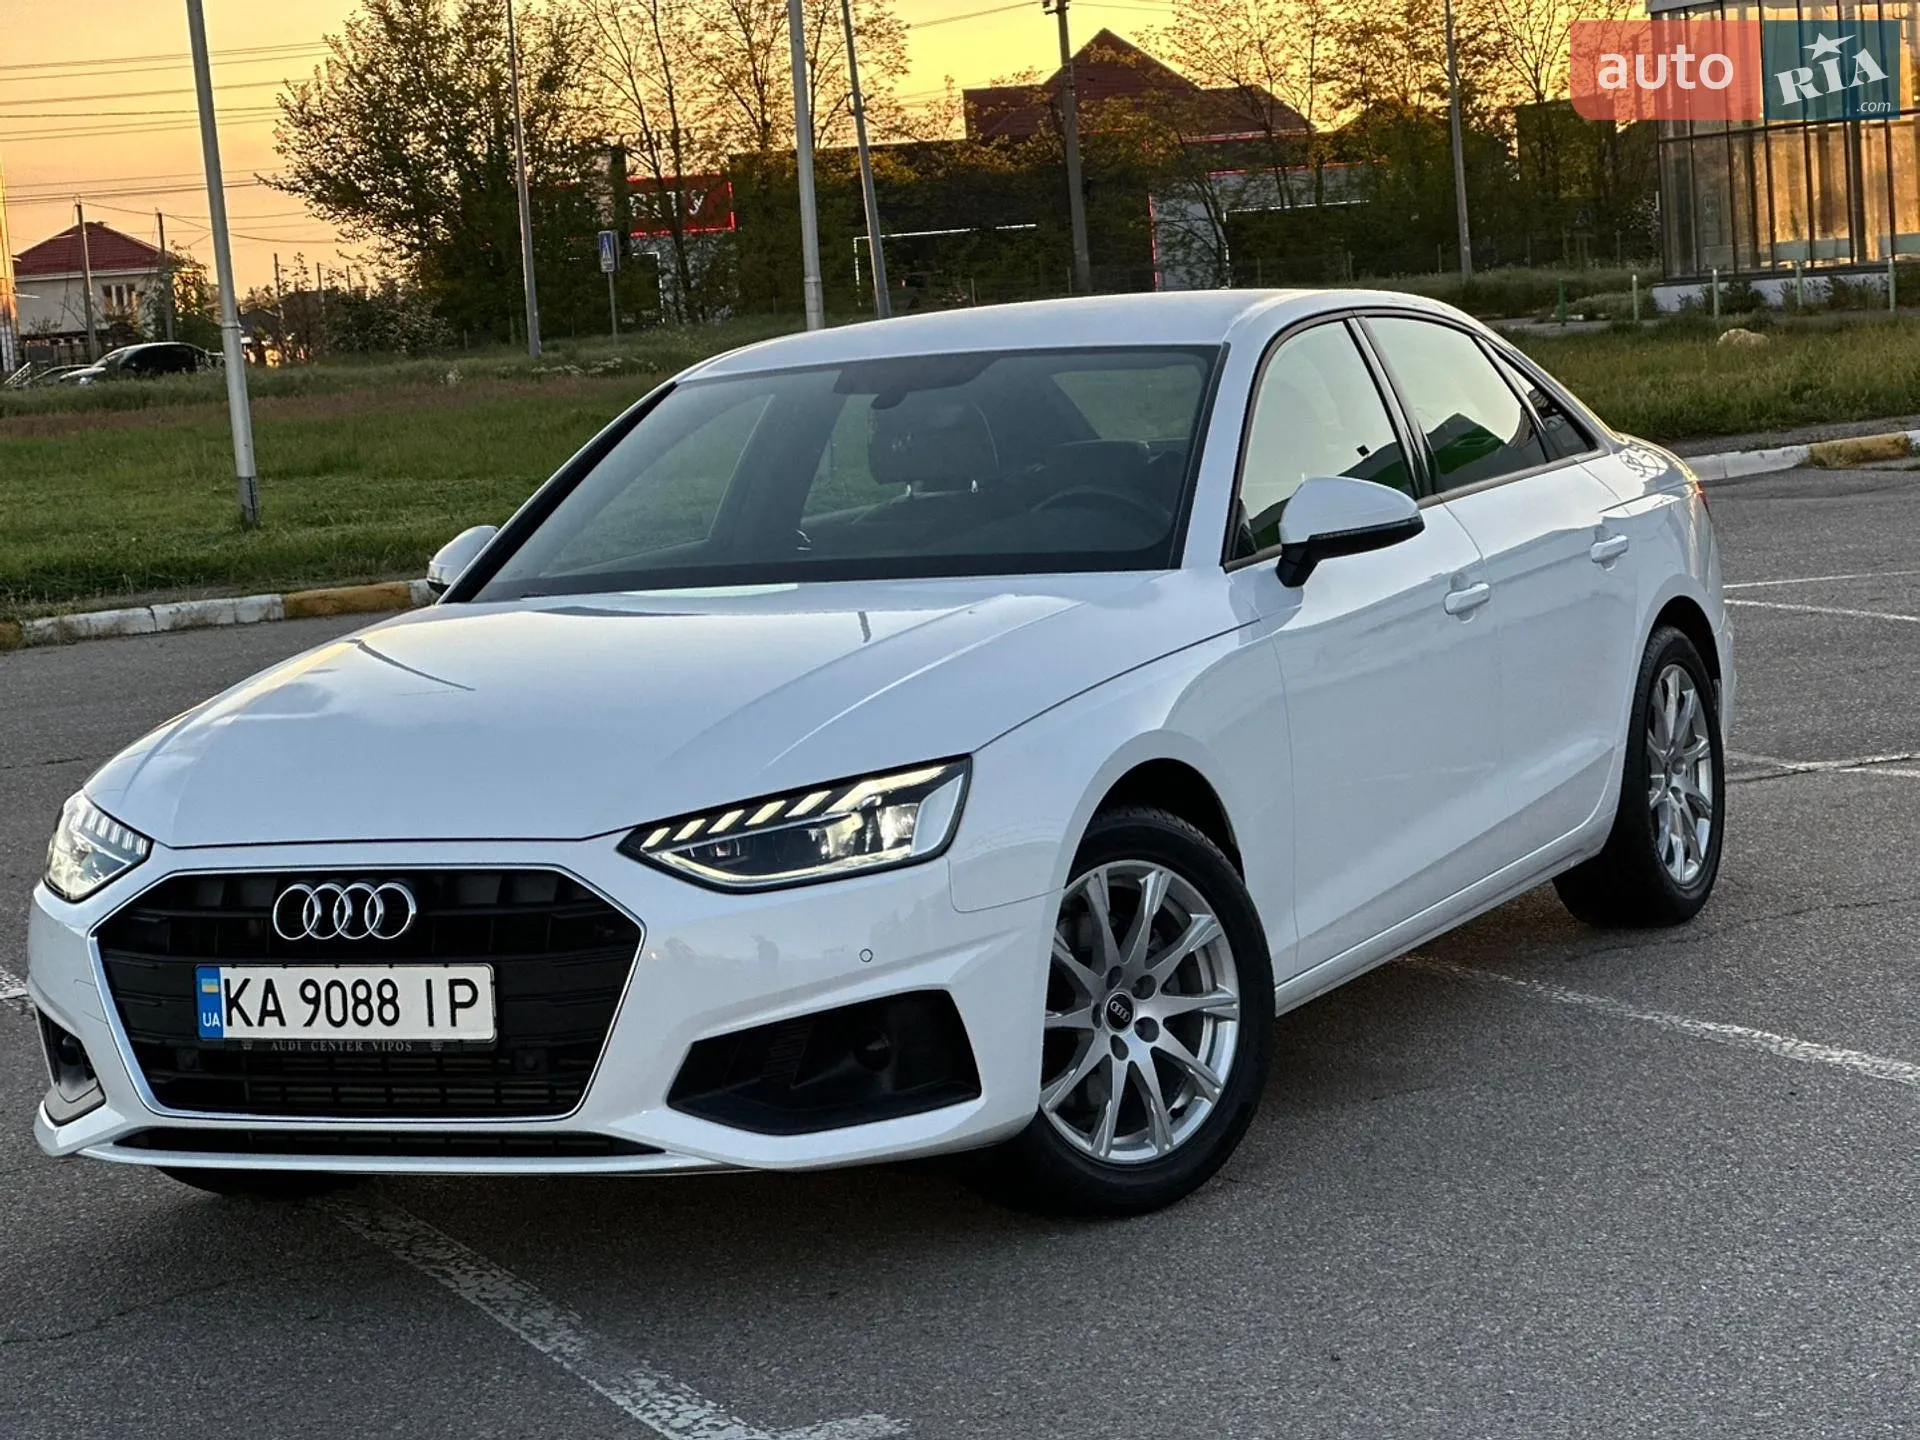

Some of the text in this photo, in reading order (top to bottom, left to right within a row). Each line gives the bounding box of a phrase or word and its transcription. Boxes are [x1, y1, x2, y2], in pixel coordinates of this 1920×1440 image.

[223, 978, 480, 1028] KA 9088 IP
[202, 1012, 220, 1027] UA
[271, 1040, 413, 1052] AUDI CENTER VIPOS
